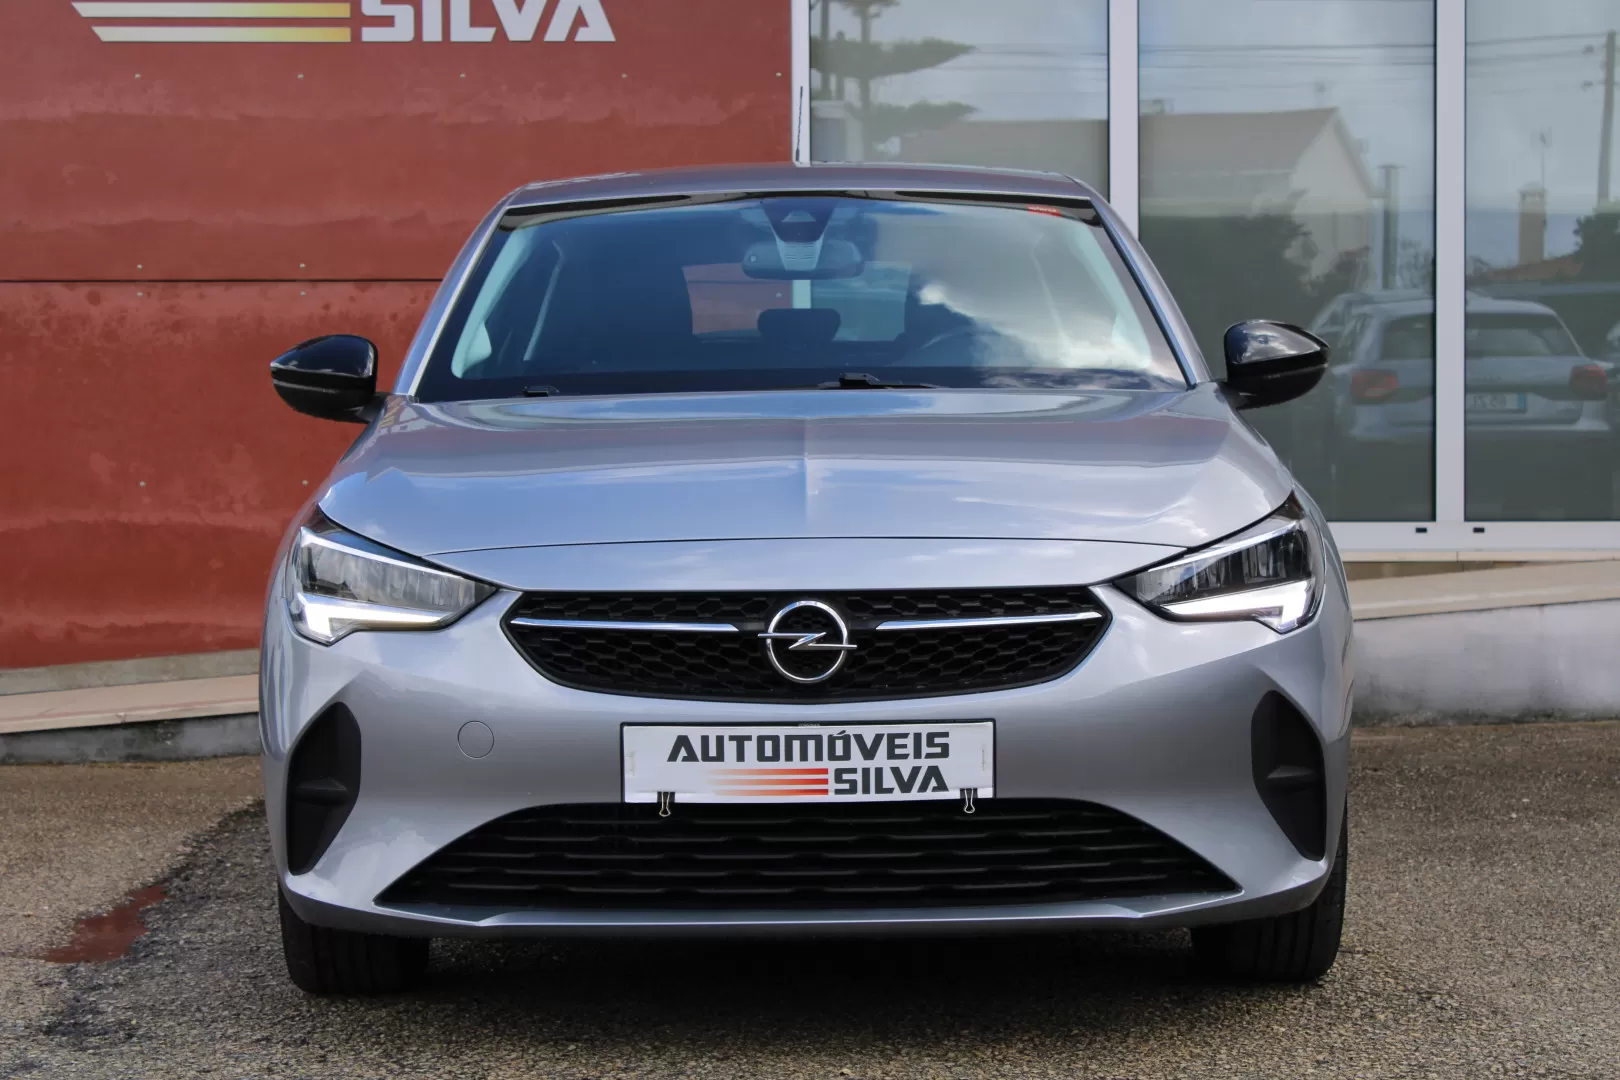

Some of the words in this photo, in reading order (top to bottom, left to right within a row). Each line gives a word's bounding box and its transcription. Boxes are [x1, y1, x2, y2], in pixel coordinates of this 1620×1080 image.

[361, 0, 616, 42] SILVA
[666, 730, 950, 763] AUTOMÓVEIS
[834, 765, 949, 795] SILVA
